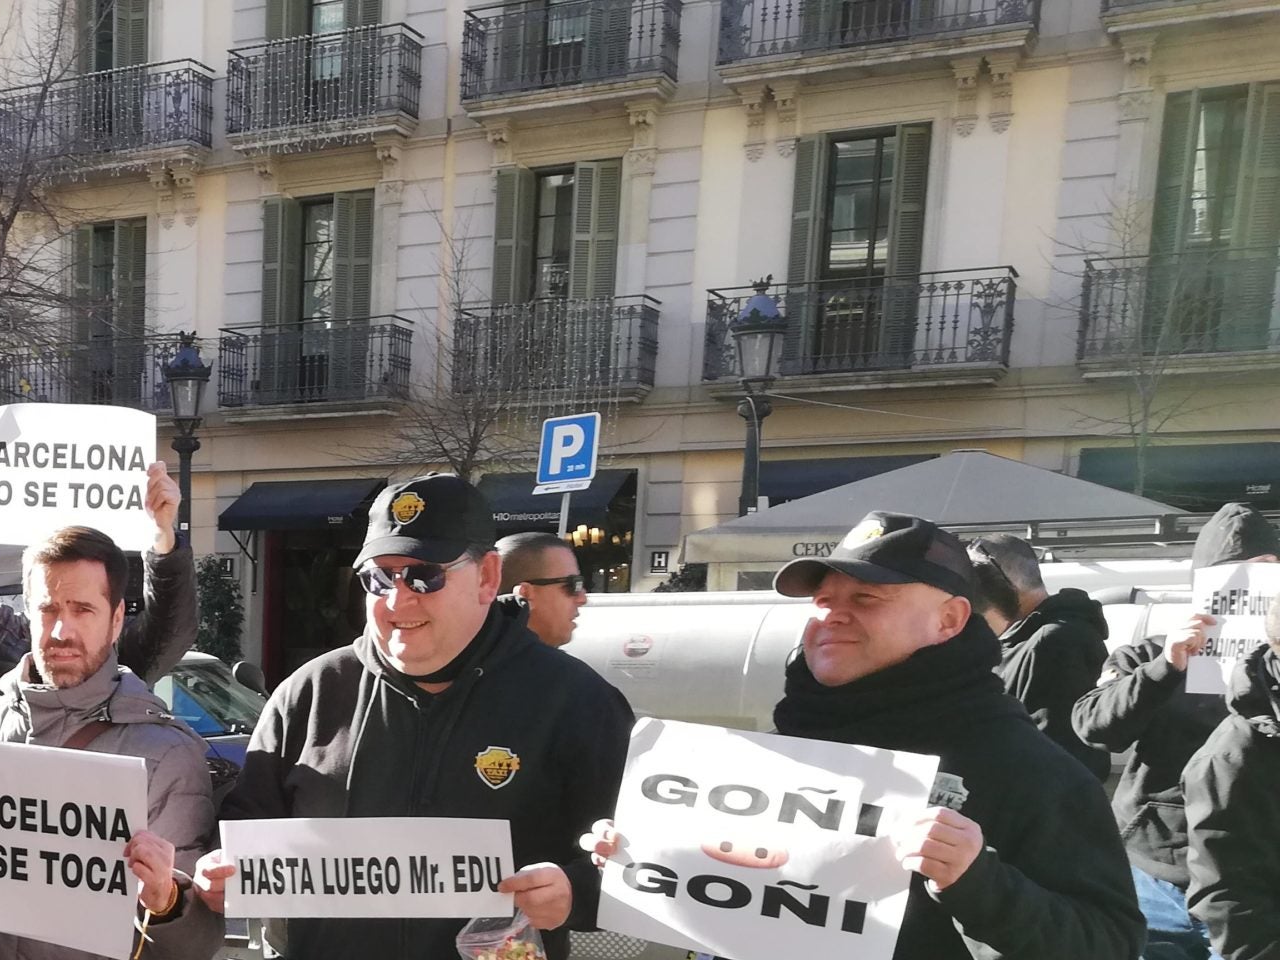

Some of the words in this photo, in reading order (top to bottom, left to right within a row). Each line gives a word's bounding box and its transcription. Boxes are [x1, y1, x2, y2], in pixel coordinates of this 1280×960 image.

[549, 424, 585, 475] P
[23, 481, 58, 507] SE
[68, 482, 144, 510] TOCA
[641, 773, 884, 837] GOÑI
[40, 850, 128, 896] TOCA
[239, 857, 315, 895] HASTA
[321, 856, 401, 895] LUEGO
[409, 855, 445, 894] Mr.
[452, 855, 504, 892] EDU
[622, 862, 868, 935] GOÑI
